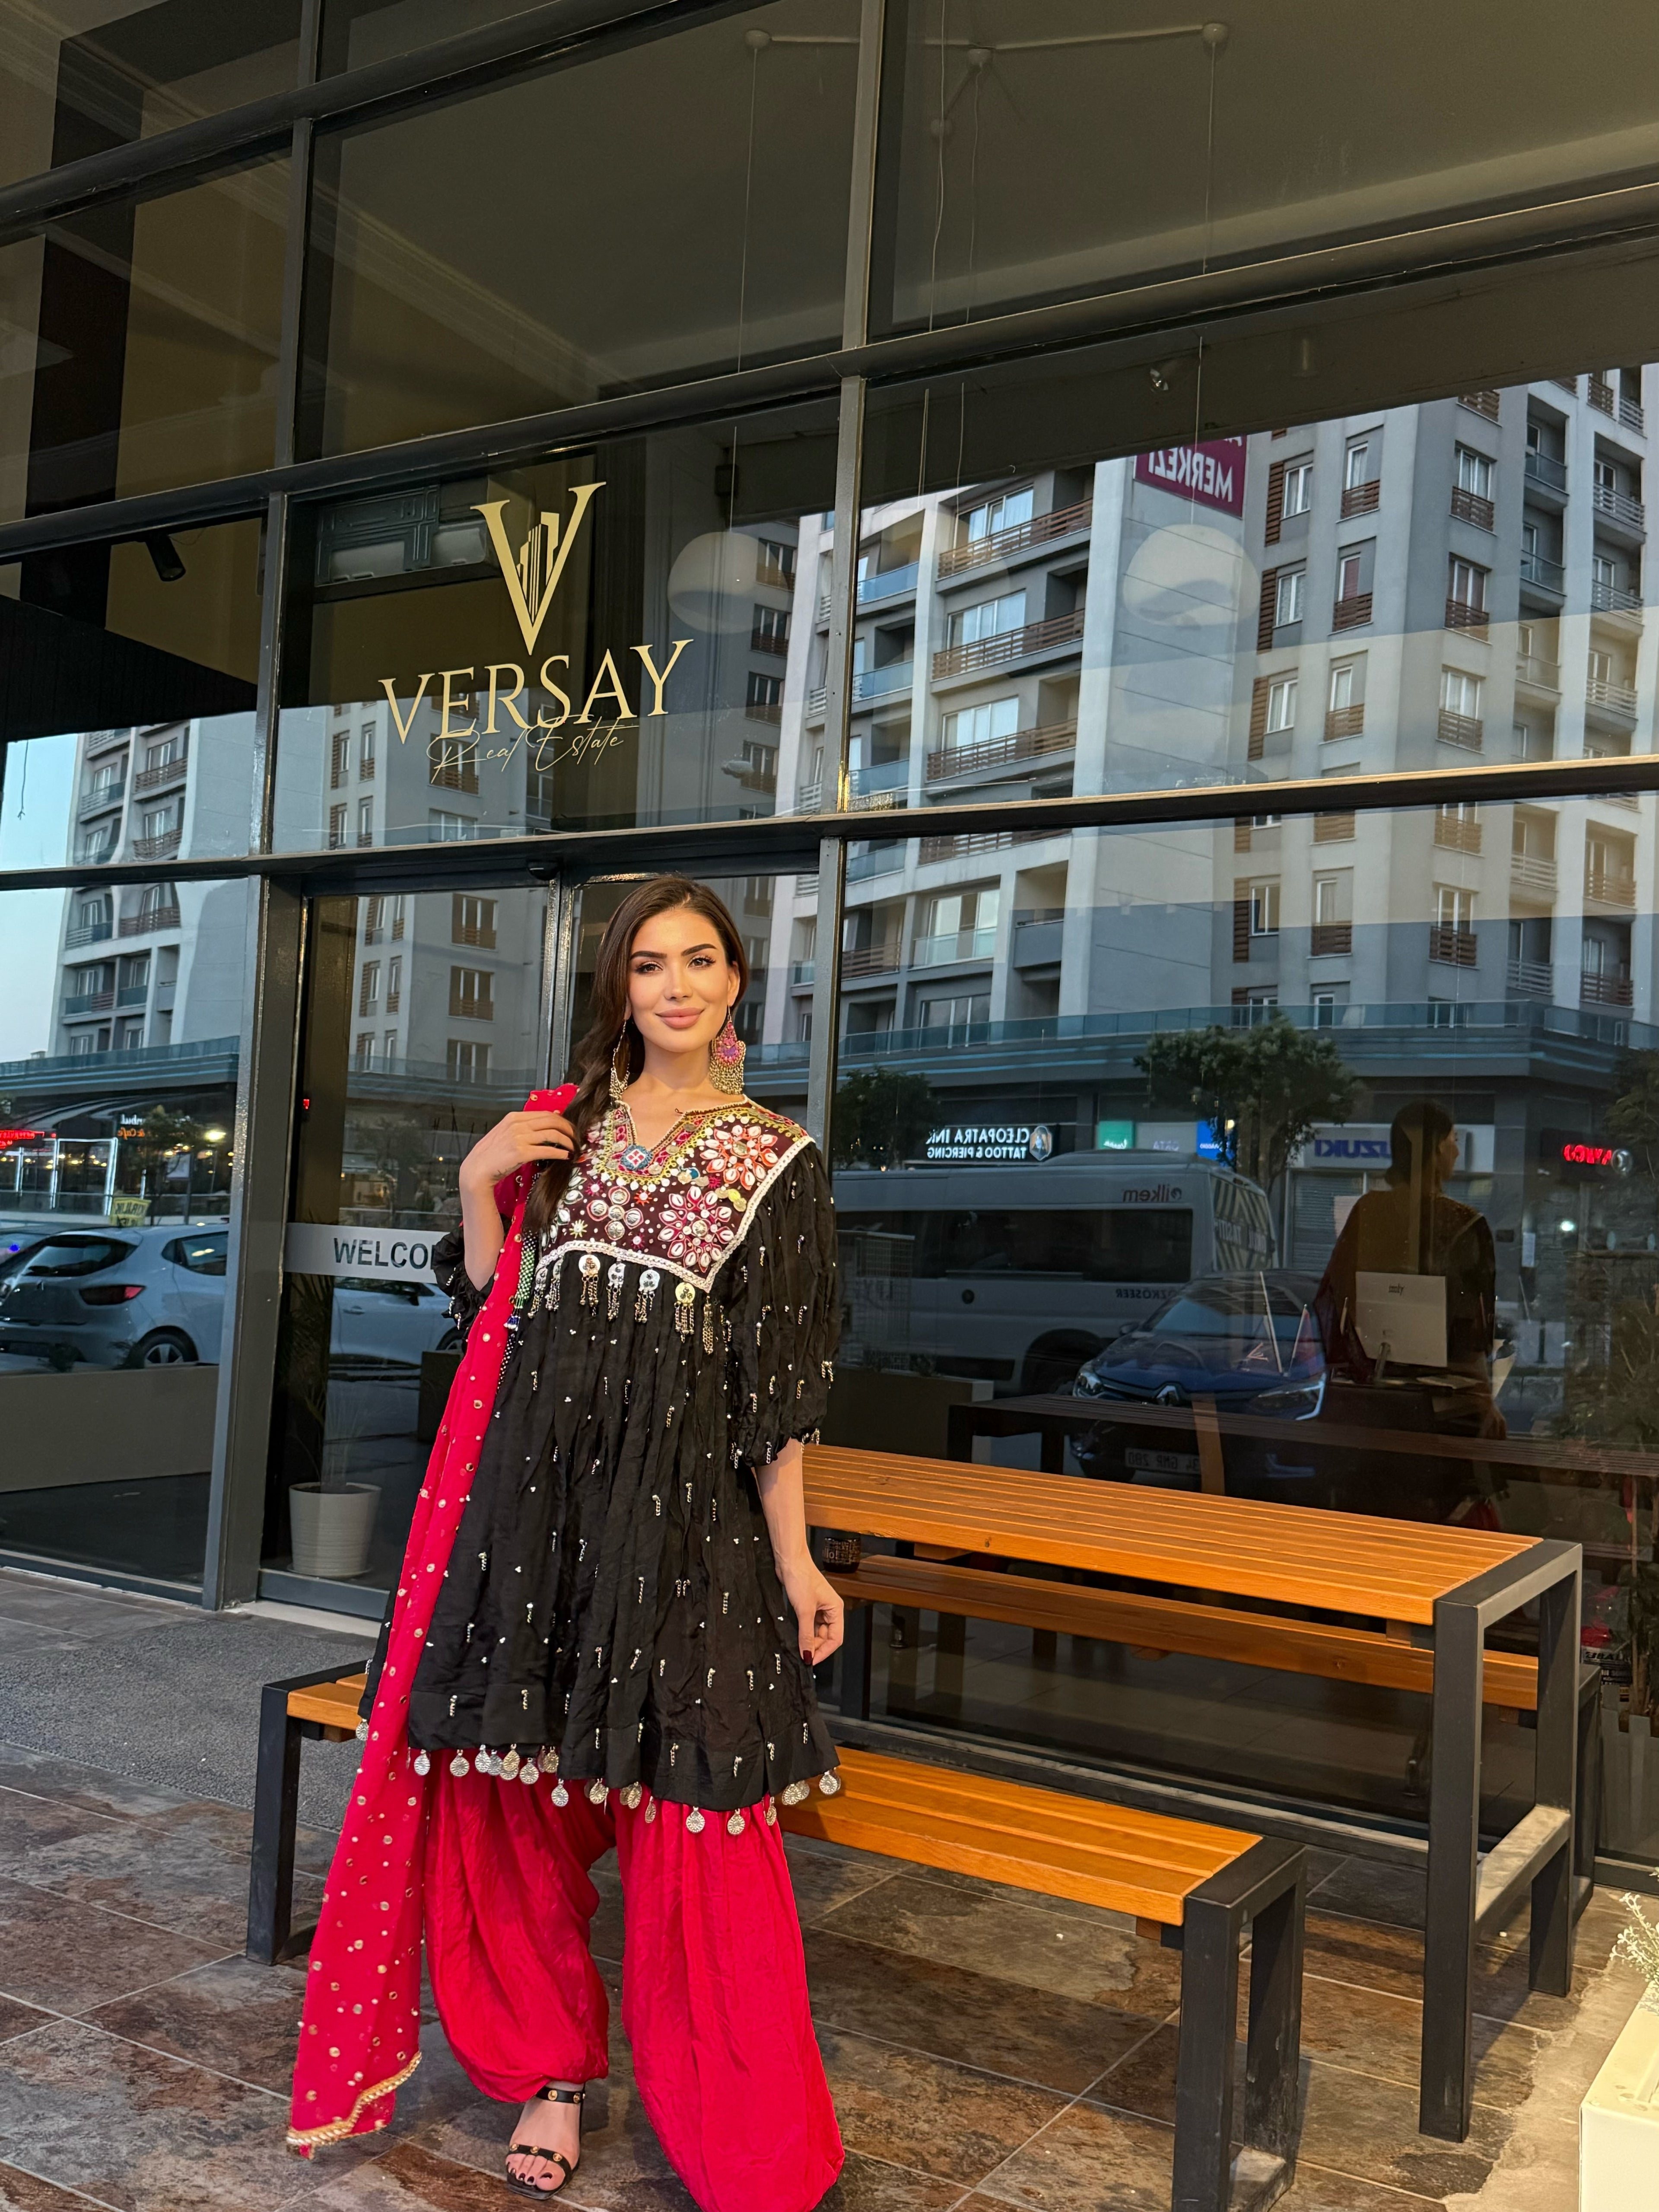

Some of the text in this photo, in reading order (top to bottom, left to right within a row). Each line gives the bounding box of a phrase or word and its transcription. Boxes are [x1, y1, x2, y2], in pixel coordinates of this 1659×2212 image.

[378, 639, 694, 744] VERSAY
[426, 714, 639, 784] Real Estate
[333, 1237, 435, 1270] WELCO
